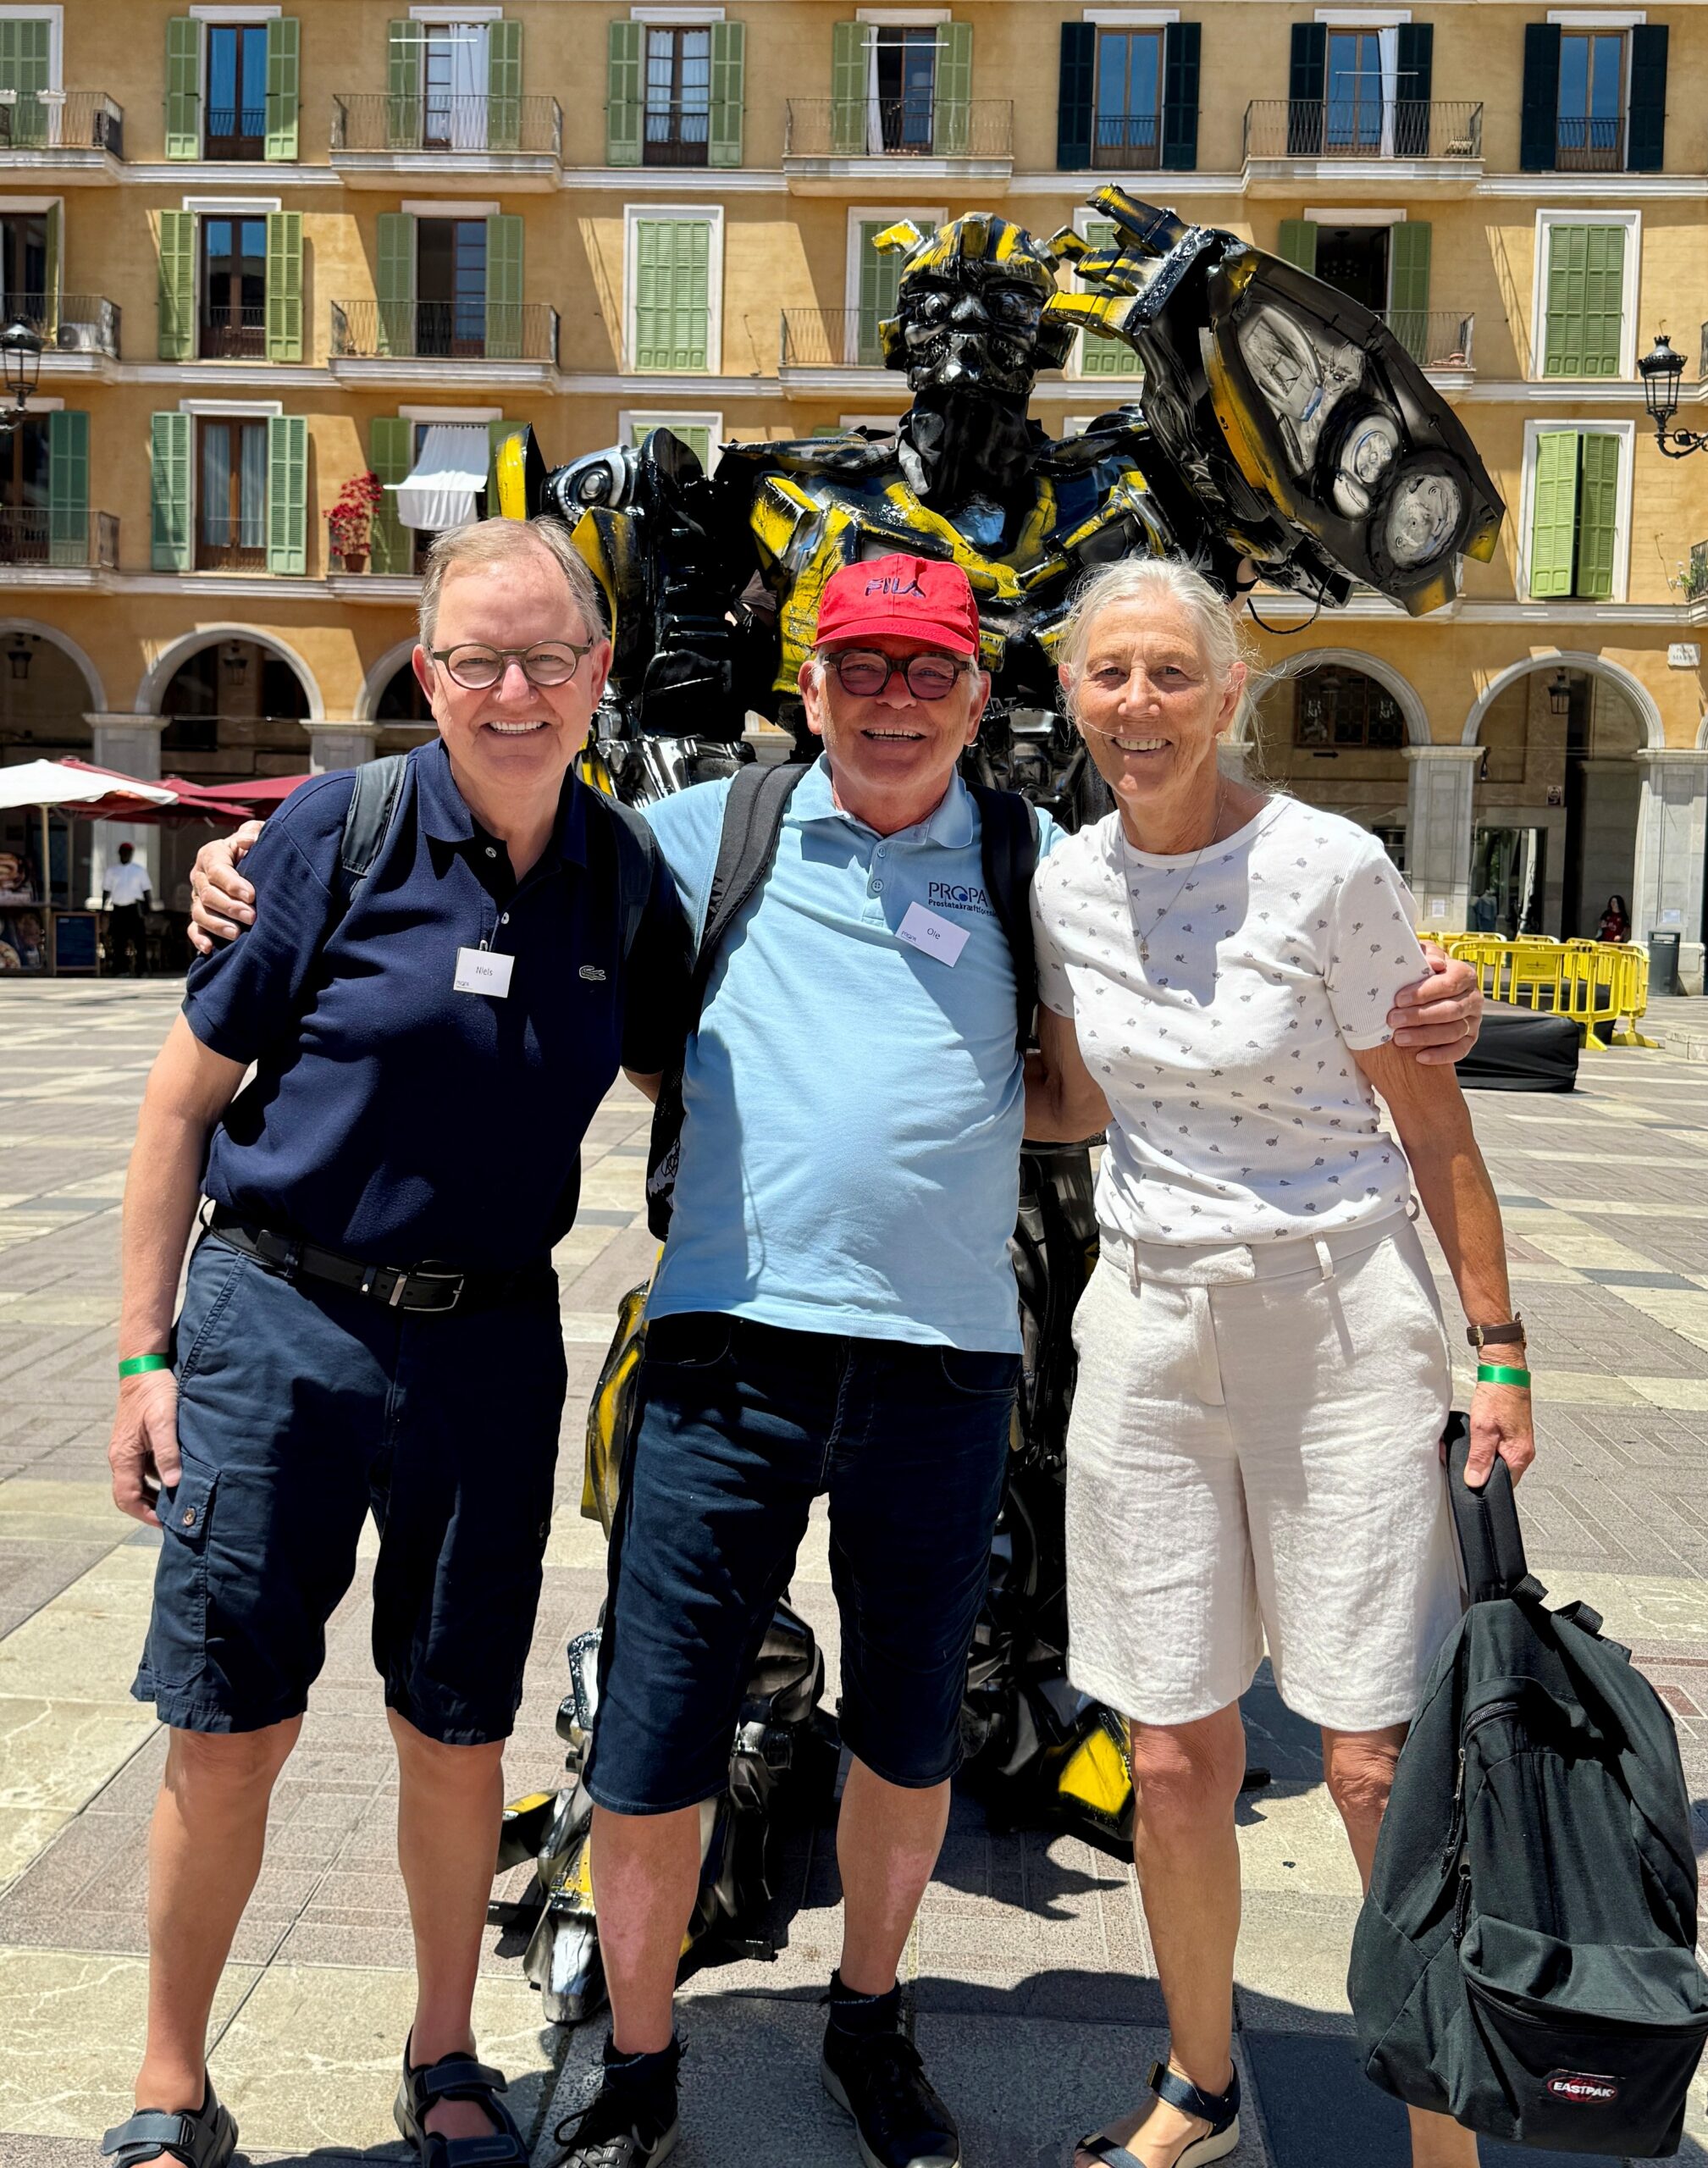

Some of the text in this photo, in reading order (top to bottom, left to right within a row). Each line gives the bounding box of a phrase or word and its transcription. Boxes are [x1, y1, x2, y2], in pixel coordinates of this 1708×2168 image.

[865, 577, 926, 598] FILA
[928, 882, 988, 907] PROPA
[926, 927, 941, 940] Ole
[475, 965, 494, 976] Niels
[1553, 2082, 1615, 2097] EASTPAK
